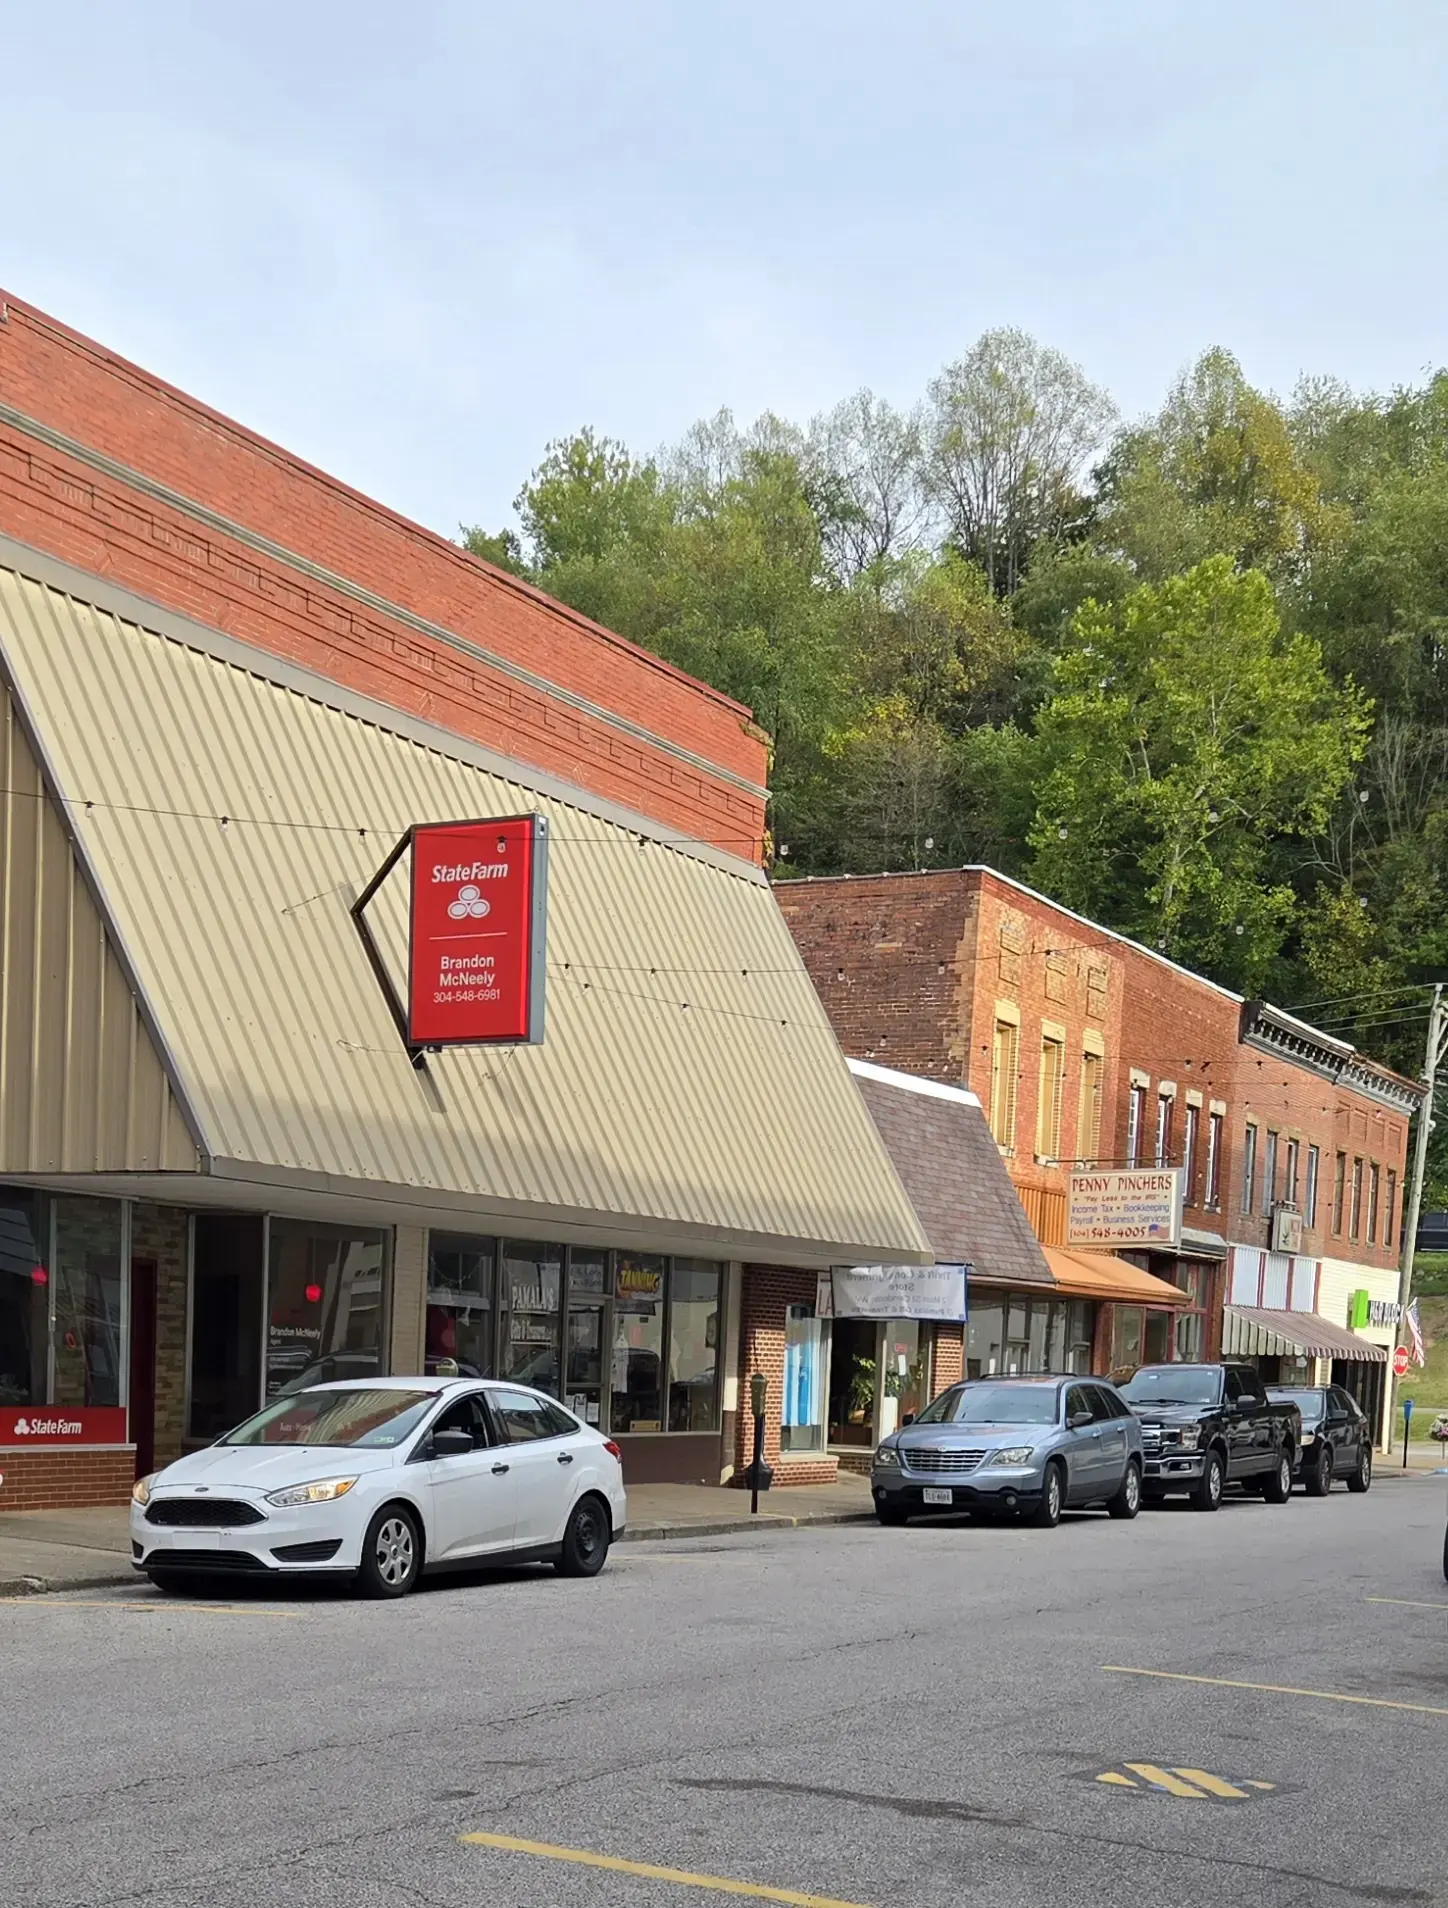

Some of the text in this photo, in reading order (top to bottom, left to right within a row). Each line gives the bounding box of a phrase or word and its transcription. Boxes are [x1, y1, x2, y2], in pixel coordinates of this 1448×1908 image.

[440, 955, 494, 970] Brandon
[439, 971, 495, 988] McNeely
[433, 989, 500, 1003] 304-548-6981
[1072, 1175, 1172, 1192] PENNY PINCHERS
[1071, 1203, 1170, 1213] Income Tax Bookkeeping
[1070, 1214, 1170, 1226] Payroll Business Services
[1091, 1226, 1146, 1238] 548-4005
[621, 1270, 659, 1290] TANNING
[270, 1326, 321, 1339] Brandon McNeely
[1394, 1355, 1408, 1366] STOP
